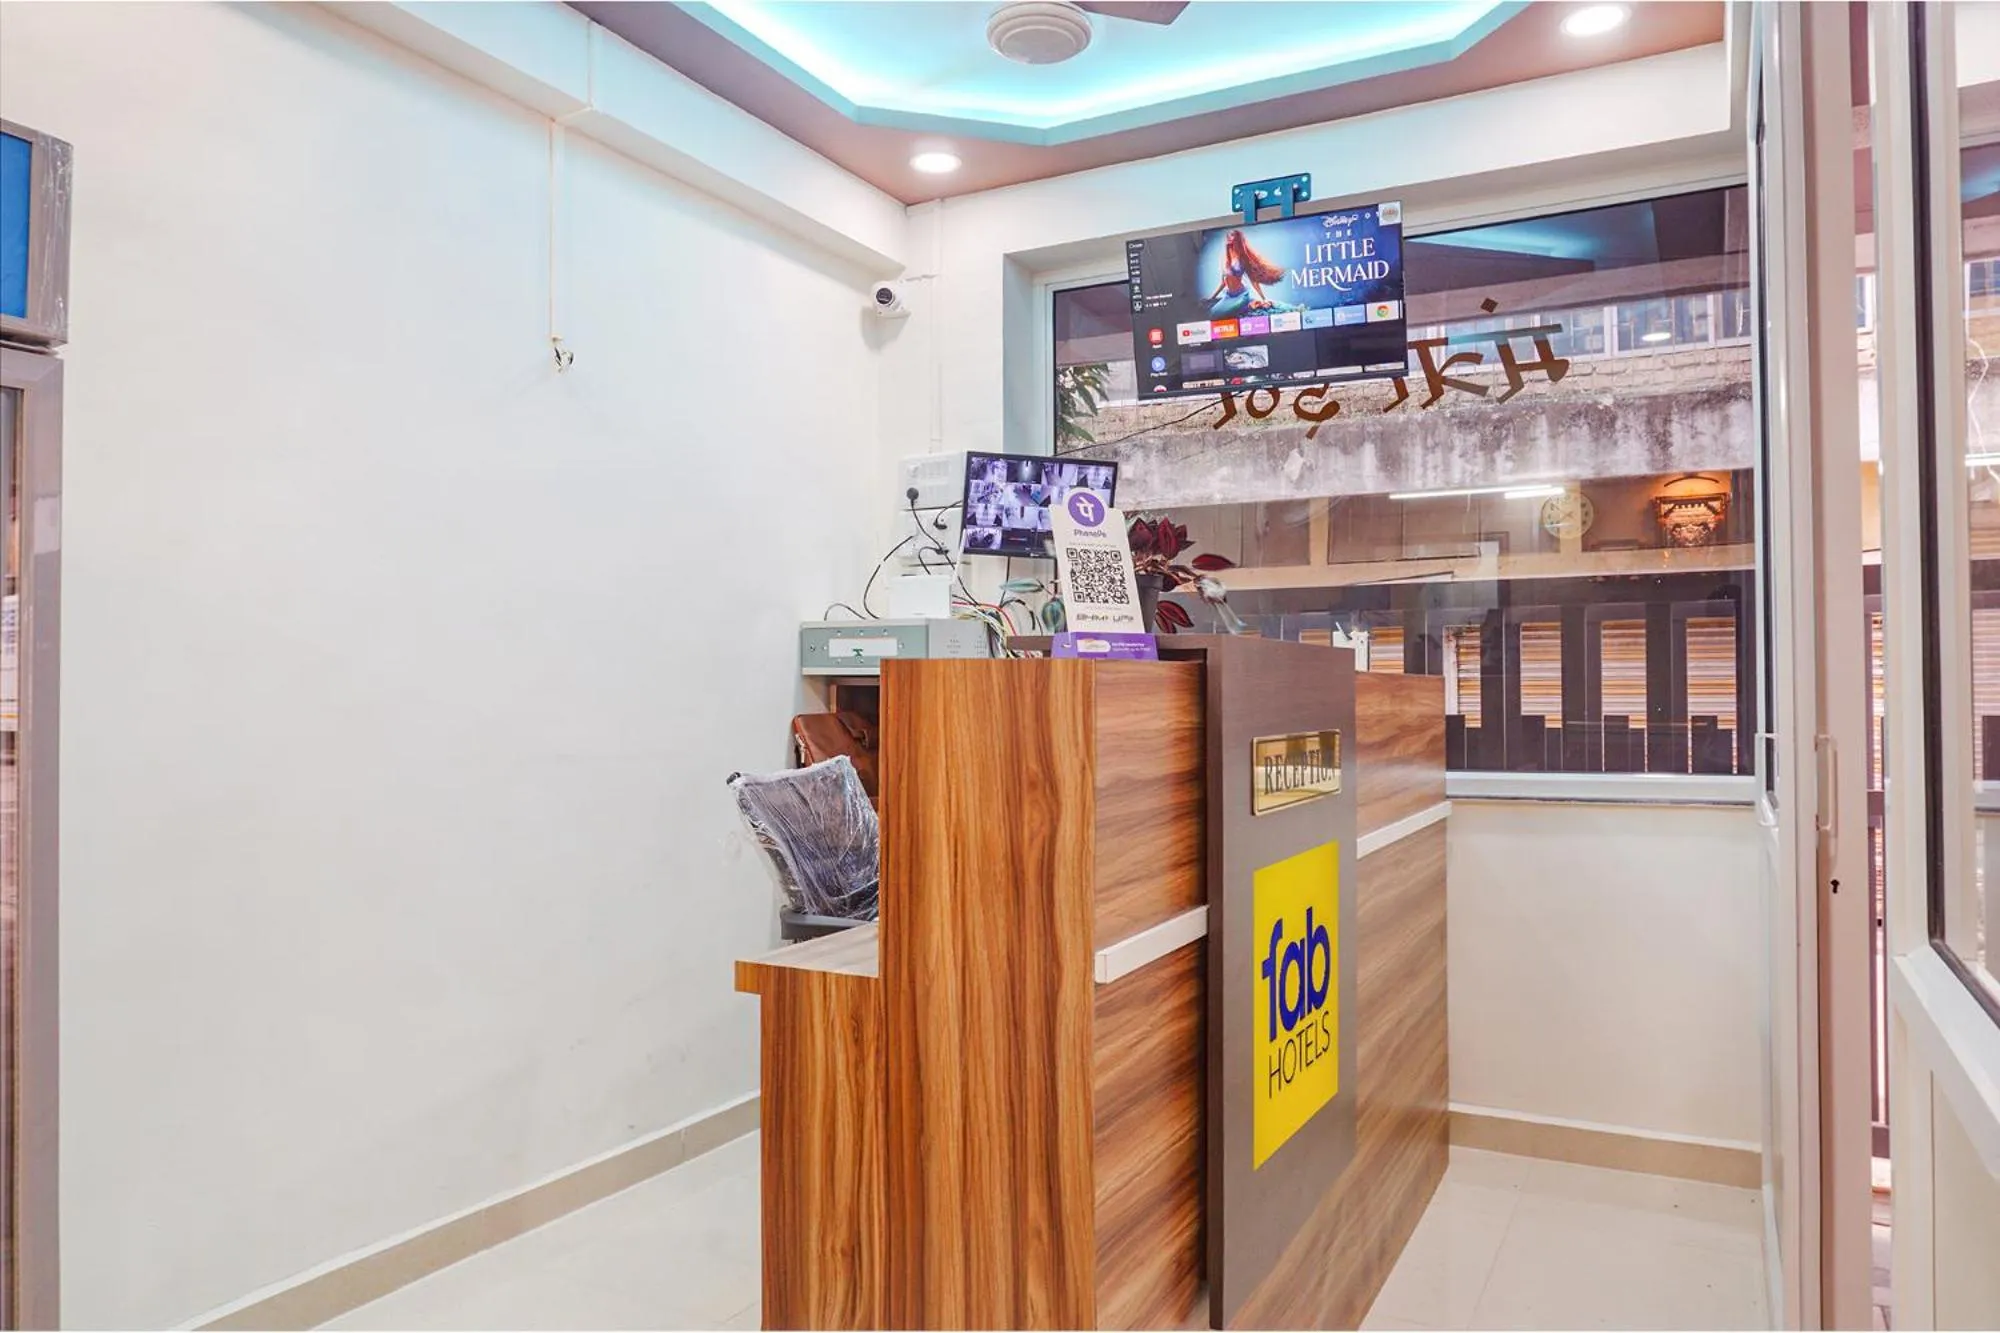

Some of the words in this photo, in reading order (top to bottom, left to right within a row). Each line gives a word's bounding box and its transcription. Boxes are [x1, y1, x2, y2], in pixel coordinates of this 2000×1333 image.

[1290, 260, 1390, 291] MERMAID
[1305, 237, 1376, 265] LITTLE
[1262, 906, 1331, 1043] fab
[1268, 1010, 1331, 1099] HOTELS
